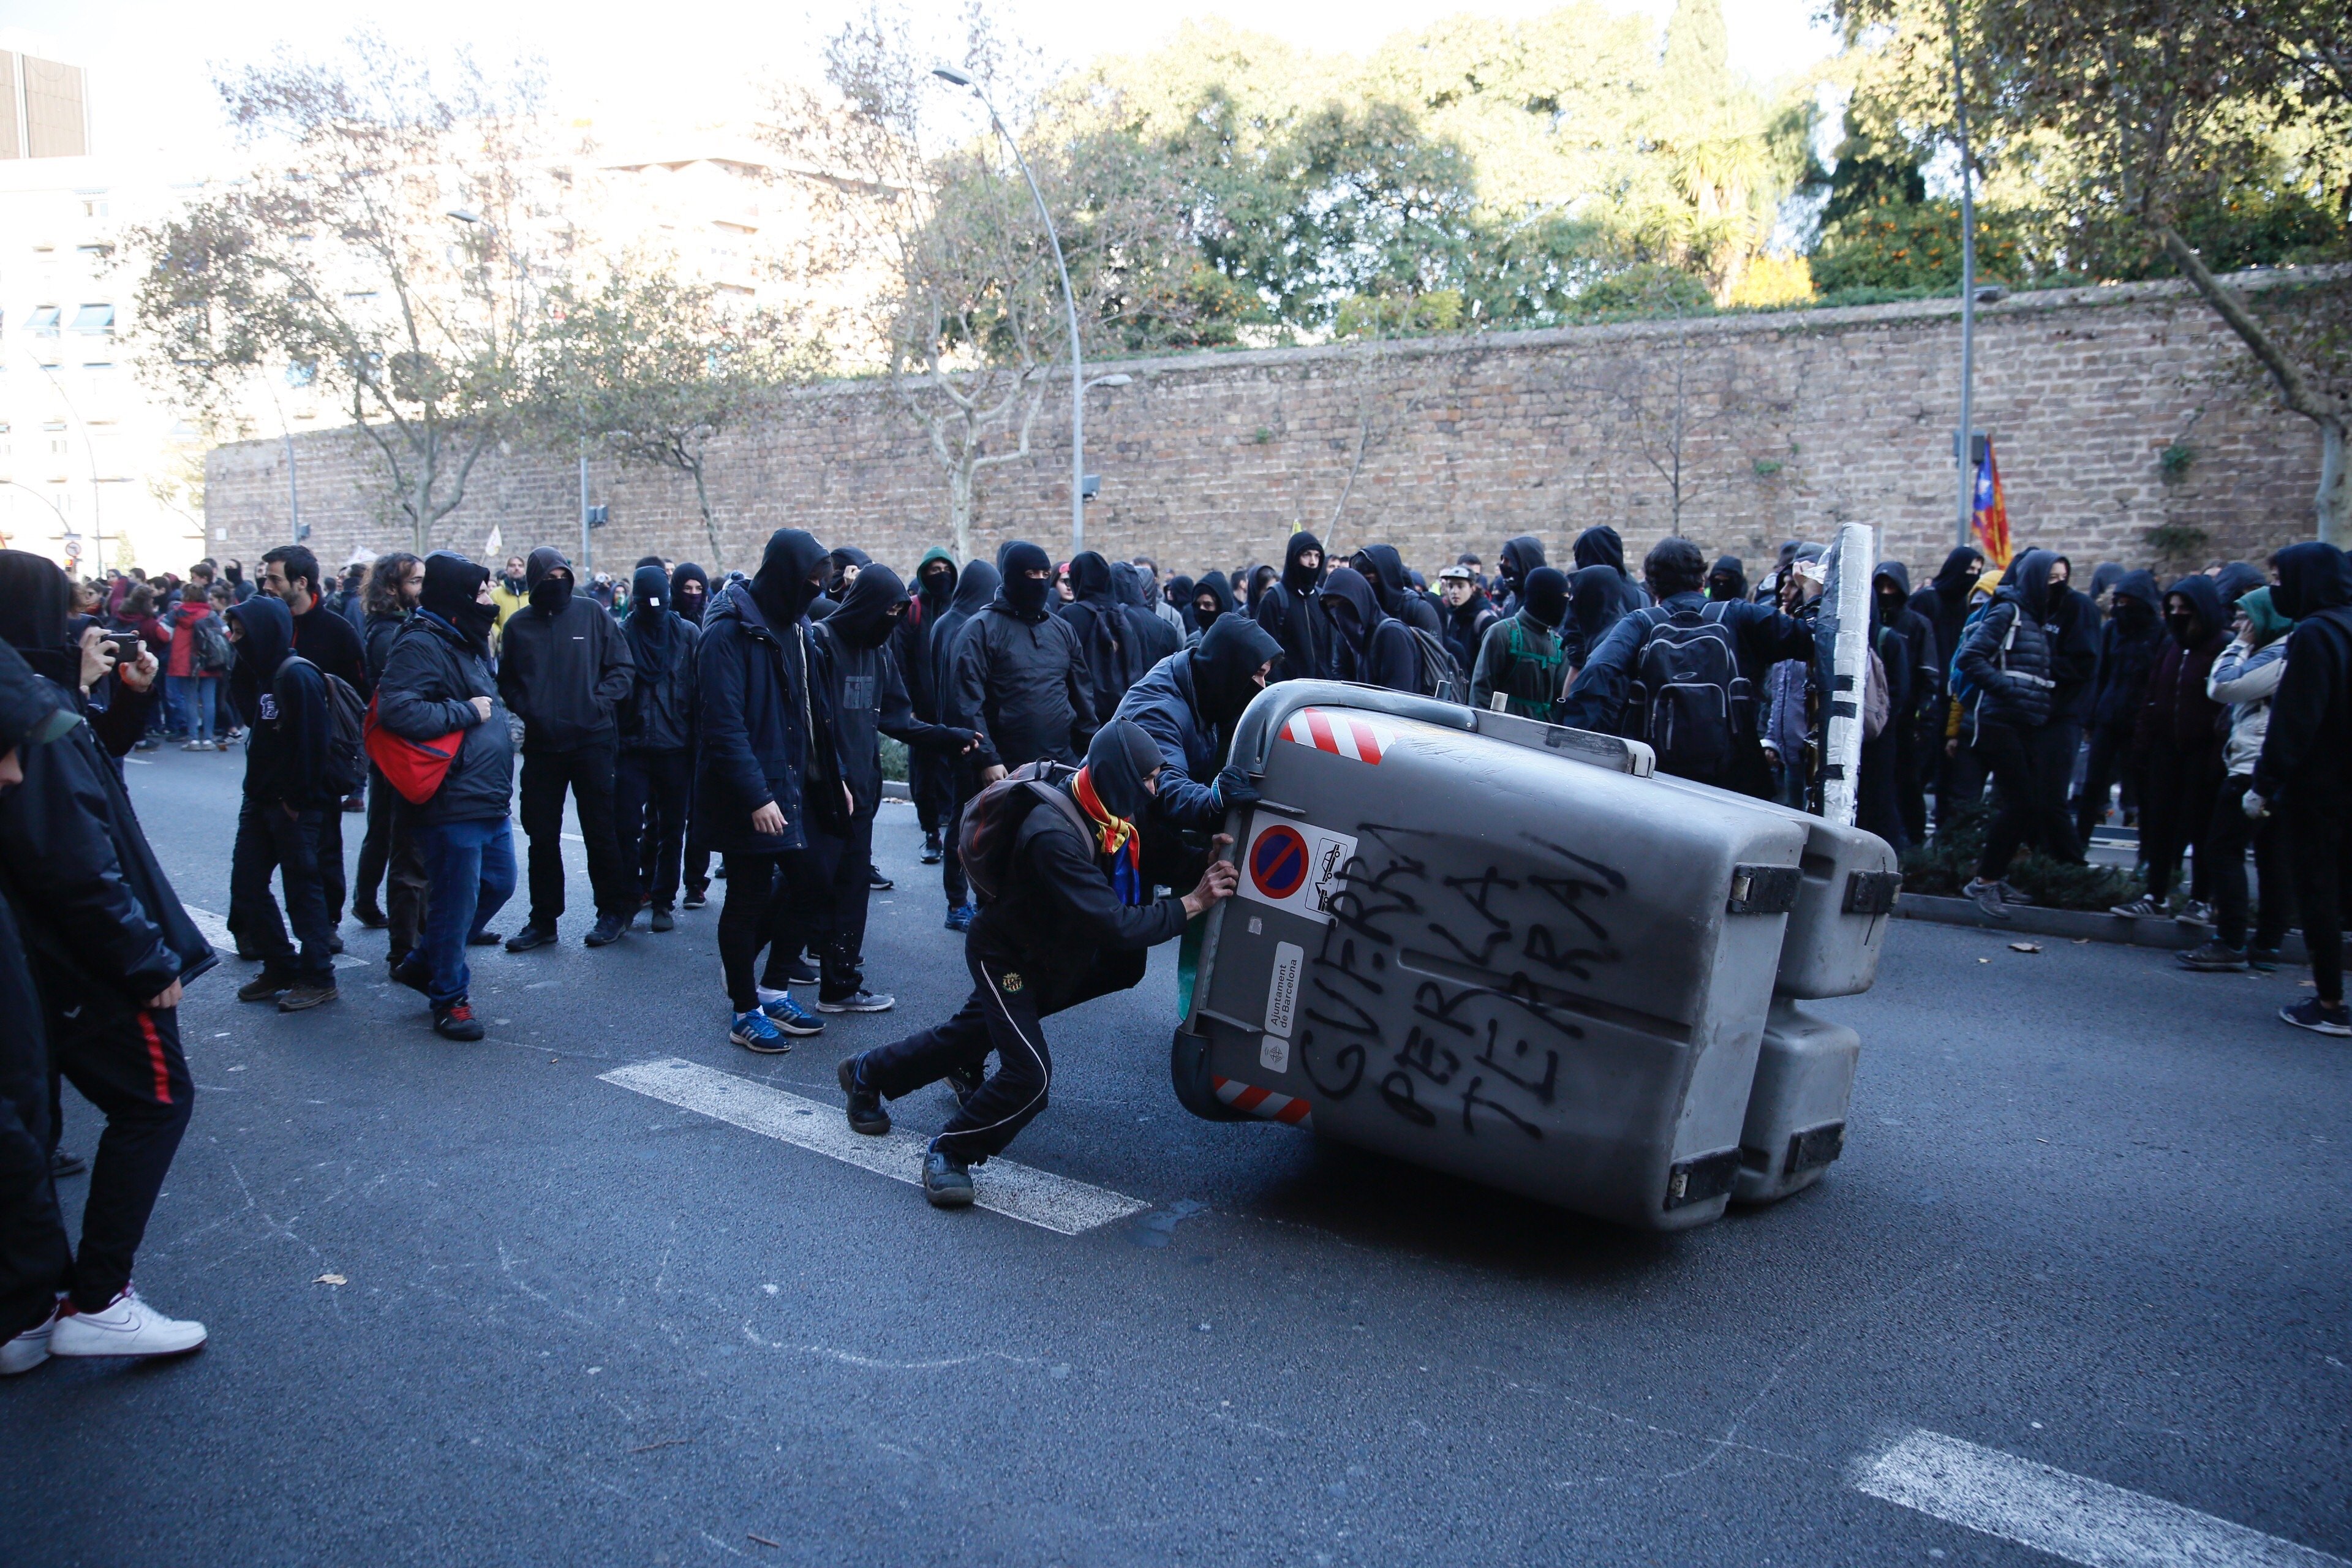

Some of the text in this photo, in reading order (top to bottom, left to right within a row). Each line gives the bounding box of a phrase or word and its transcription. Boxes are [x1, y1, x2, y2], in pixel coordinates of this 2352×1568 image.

[1271, 965, 1287, 1026] Ajuntament
[1280, 959, 1297, 1028] de Barcelona
[1380, 865, 1518, 1128] PER LA
